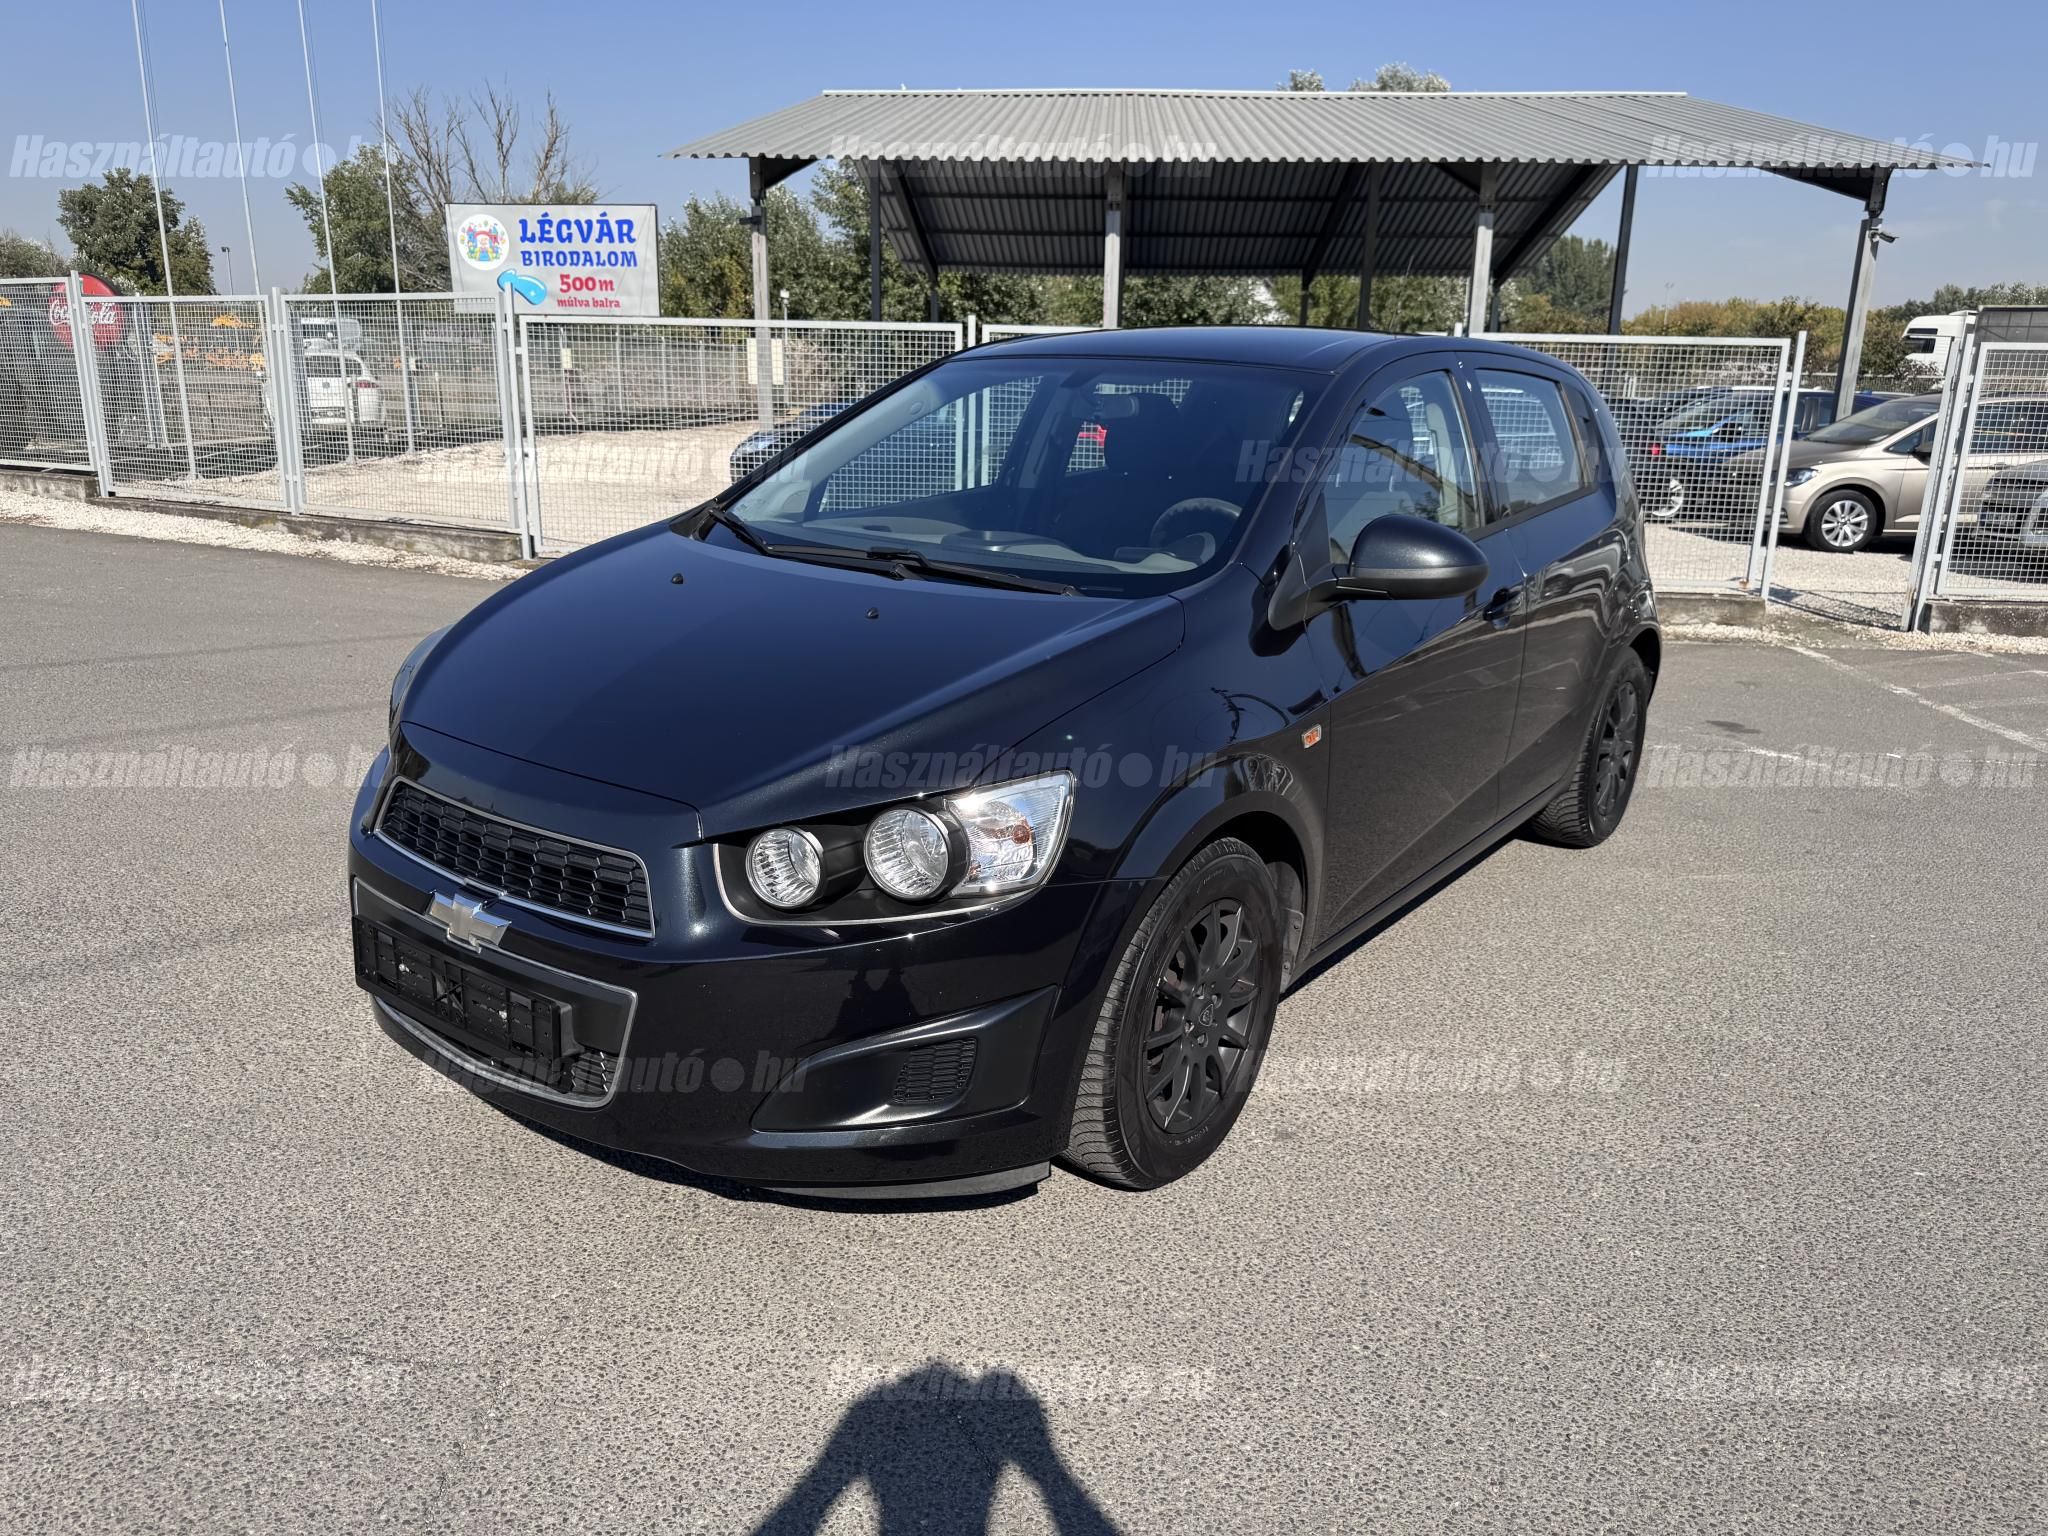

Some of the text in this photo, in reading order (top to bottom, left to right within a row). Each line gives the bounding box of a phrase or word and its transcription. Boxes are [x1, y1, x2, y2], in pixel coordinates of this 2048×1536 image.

[518, 211, 637, 244] LÉGVÁR
[519, 250, 638, 267] BIRODALOM
[559, 273, 615, 293] 500 m
[557, 296, 621, 308] múlva balra
